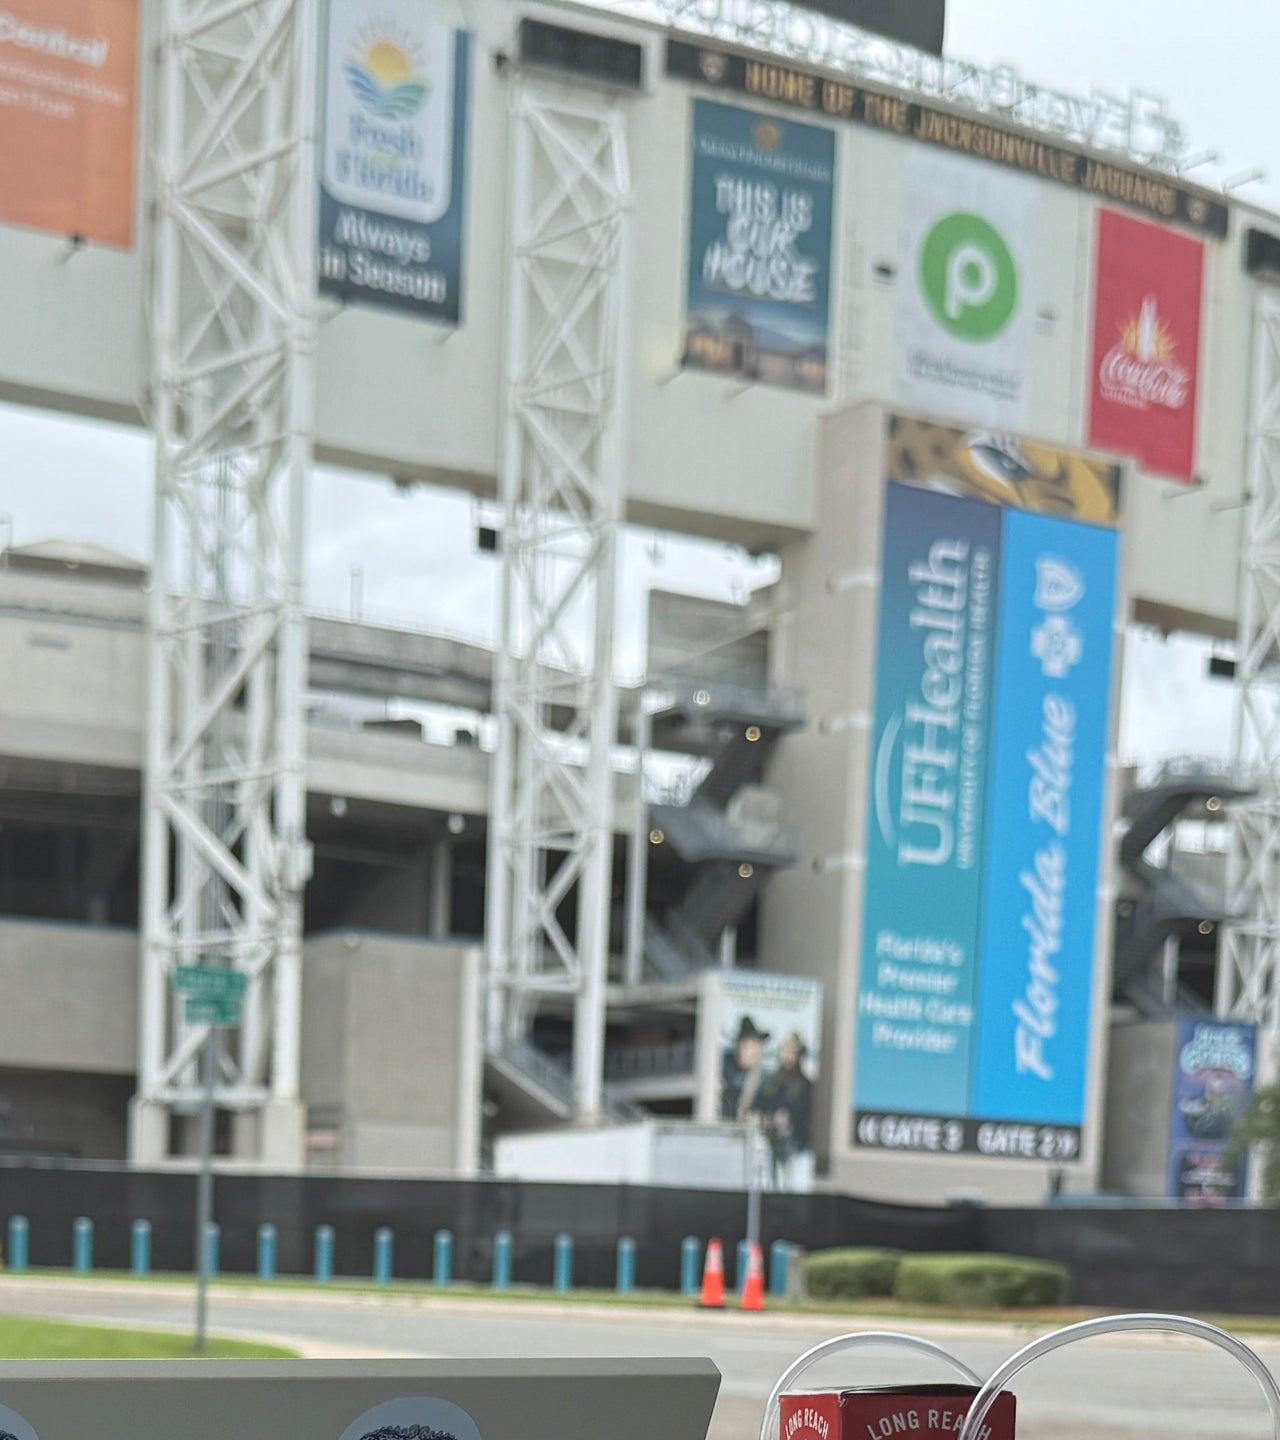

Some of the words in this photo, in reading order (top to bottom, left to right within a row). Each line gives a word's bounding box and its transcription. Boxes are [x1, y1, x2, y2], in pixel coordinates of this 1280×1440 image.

[714, 175, 777, 223] THIS
[781, 189, 813, 233] IS
[335, 210, 431, 265] Always
[348, 248, 446, 304] Season
[703, 240, 817, 301] HOUSE
[1028, 694, 1078, 835] Blue
[1012, 842, 1067, 1081] Florida
[926, 995, 972, 1027] Care
[880, 1115, 940, 1150] GATE
[977, 1122, 1037, 1156] GATE
[785, 1411, 803, 1440] LONG
[804, 1408, 829, 1440] REACH
